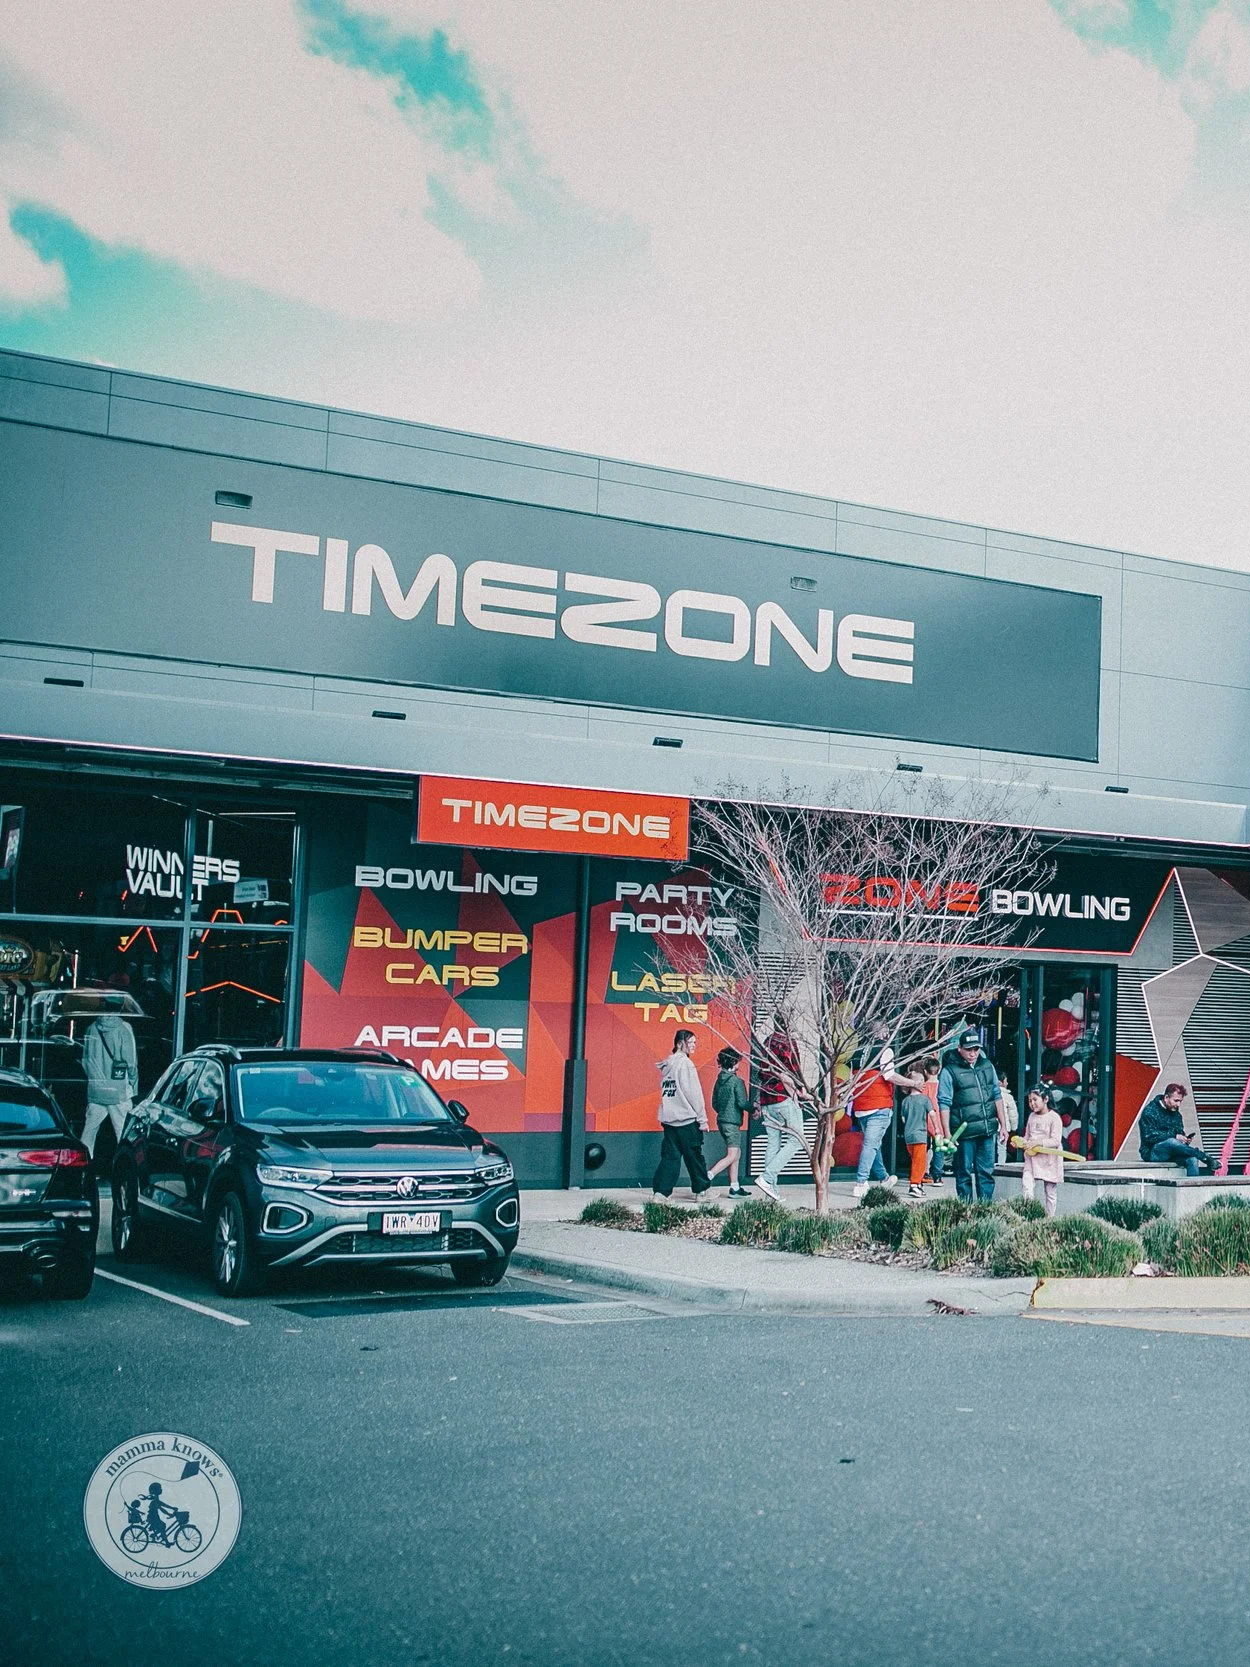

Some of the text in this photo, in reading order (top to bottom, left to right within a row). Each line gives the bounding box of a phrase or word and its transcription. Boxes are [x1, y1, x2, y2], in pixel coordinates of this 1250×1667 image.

[211, 521, 915, 685] TIMEZONE
[441, 798, 671, 839] TIMEZONE
[126, 844, 240, 883] WINNERS
[355, 865, 538, 896] BOWLING
[615, 881, 735, 907] PARTY
[820, 873, 1131, 922] ZONE BOWLING
[609, 911, 738, 937] ROOMS
[353, 926, 528, 954] BUMPER
[385, 963, 500, 987] CARS
[611, 971, 736, 994] LASER
[634, 1002, 709, 1023] TAG
[354, 1025, 524, 1049] ARCADE
